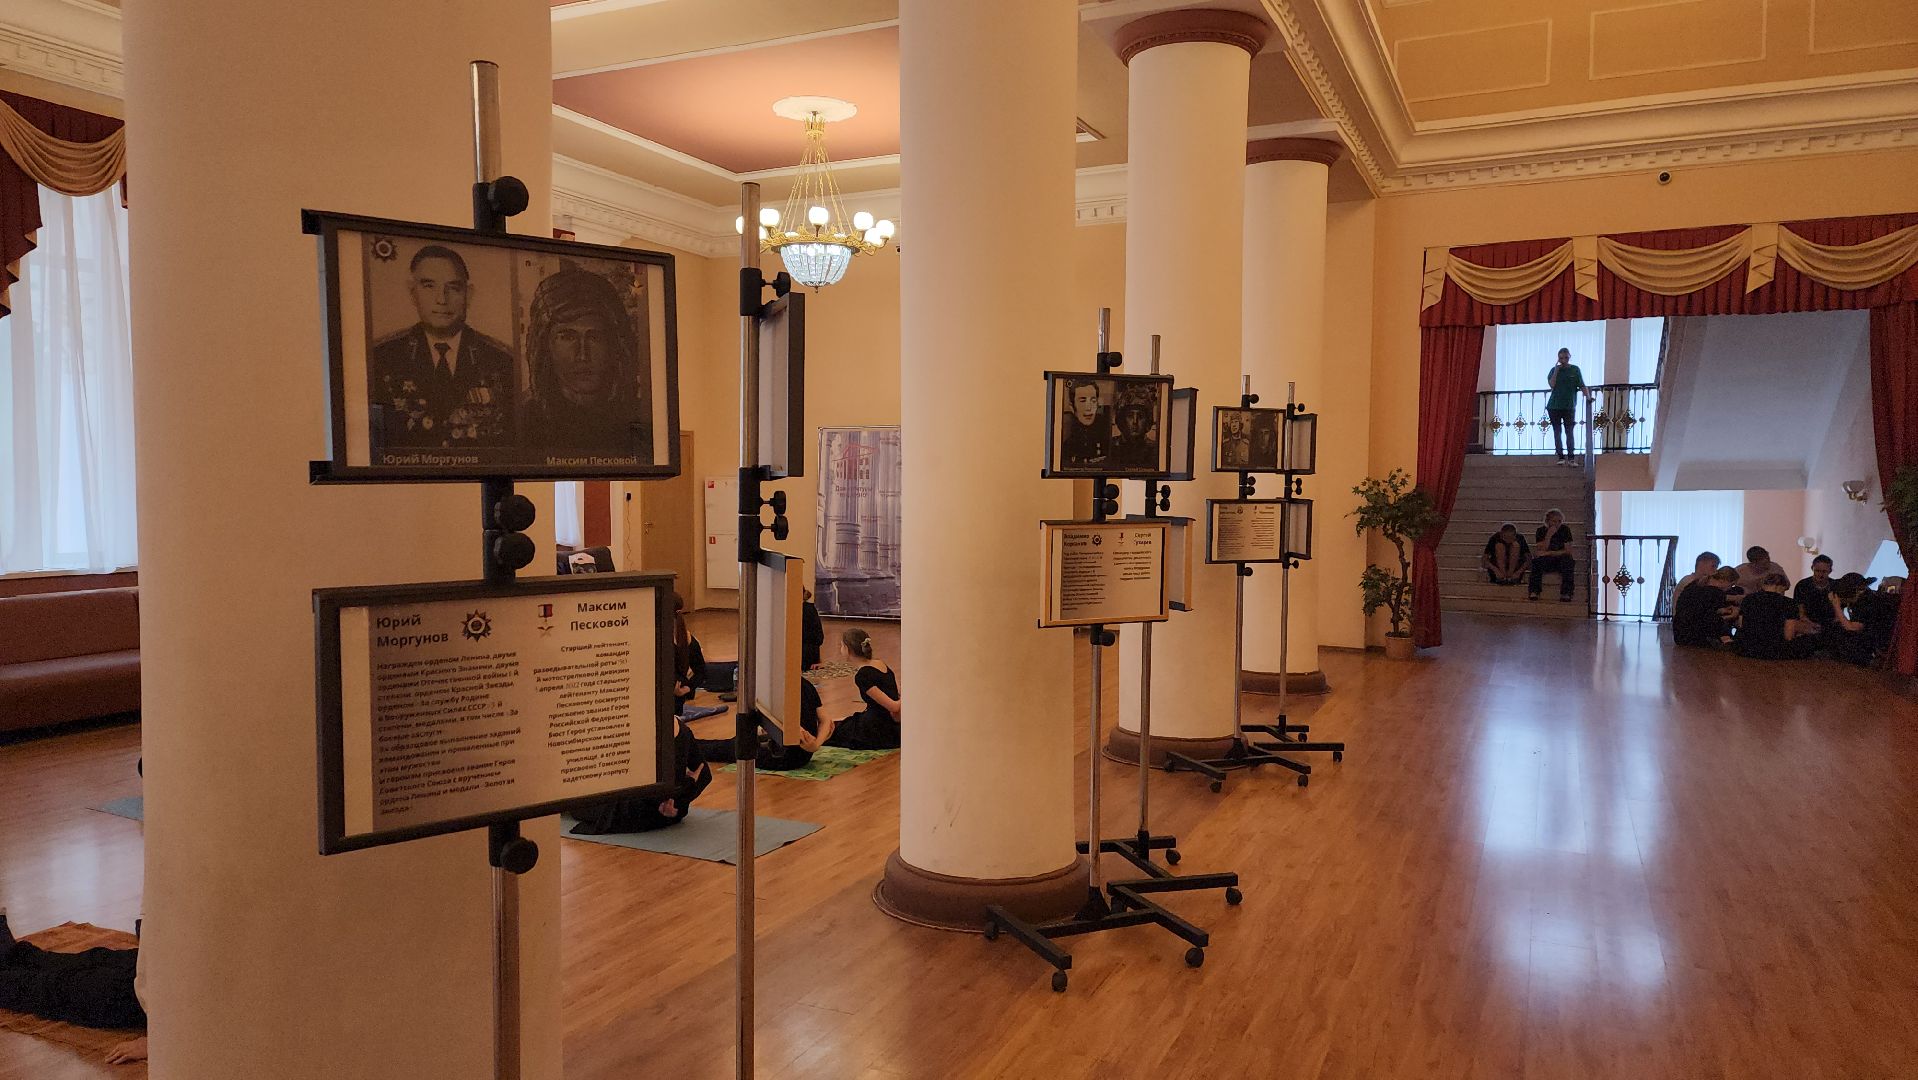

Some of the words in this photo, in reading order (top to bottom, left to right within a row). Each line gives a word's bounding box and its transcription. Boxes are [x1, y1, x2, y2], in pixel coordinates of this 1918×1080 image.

[382, 454, 420, 466] Юрий
[422, 455, 480, 466] Моргунов
[546, 456, 588, 466] Максим
[590, 456, 638, 465] Песковой
[577, 602, 627, 612] Максим
[376, 614, 422, 630] Юрий
[570, 616, 629, 631] Песковой
[377, 634, 449, 648] Моргунов
[560, 644, 592, 654] Старший
[595, 650, 630, 658] командир
[424, 656, 459, 666] орденом
[420, 668, 457, 678] Красного
[495, 661, 520, 670] двумя
[533, 661, 599, 675] разведывательной
[600, 660, 618, 669] роты
[420, 673, 482, 686] Отечественной
[482, 672, 508, 680] войны
[542, 670, 599, 682] мотострелковой
[452, 682, 484, 692] Красной
[539, 684, 564, 692] апреля
[580, 680, 596, 688] года
[596, 677, 630, 686] старшему
[460, 694, 490, 702] Родине
[559, 689, 599, 700] лейтенанту
[600, 686, 630, 694] Максиму
[556, 699, 594, 709] Песковому
[594, 694, 630, 704] посмертно
[442, 705, 466, 714] Силах
[586, 706, 610, 715] звание
[610, 703, 630, 712] Героя
[550, 717, 590, 728] Российской
[488, 726, 521, 738] заданий
[548, 730, 566, 739] Бюст
[566, 728, 586, 737] Героя
[586, 724, 626, 734] установлен
[500, 739, 515, 748] при
[547, 735, 602, 748] Новосибирском
[602, 731, 631, 740] высшем
[561, 746, 592, 756] военном
[605, 750, 616, 758] его
[616, 748, 631, 756] имя
[494, 758, 516, 768] Героя
[598, 758, 631, 768] Томскому
[562, 772, 602, 784] кадетскому
[449, 784, 480, 794] медали
